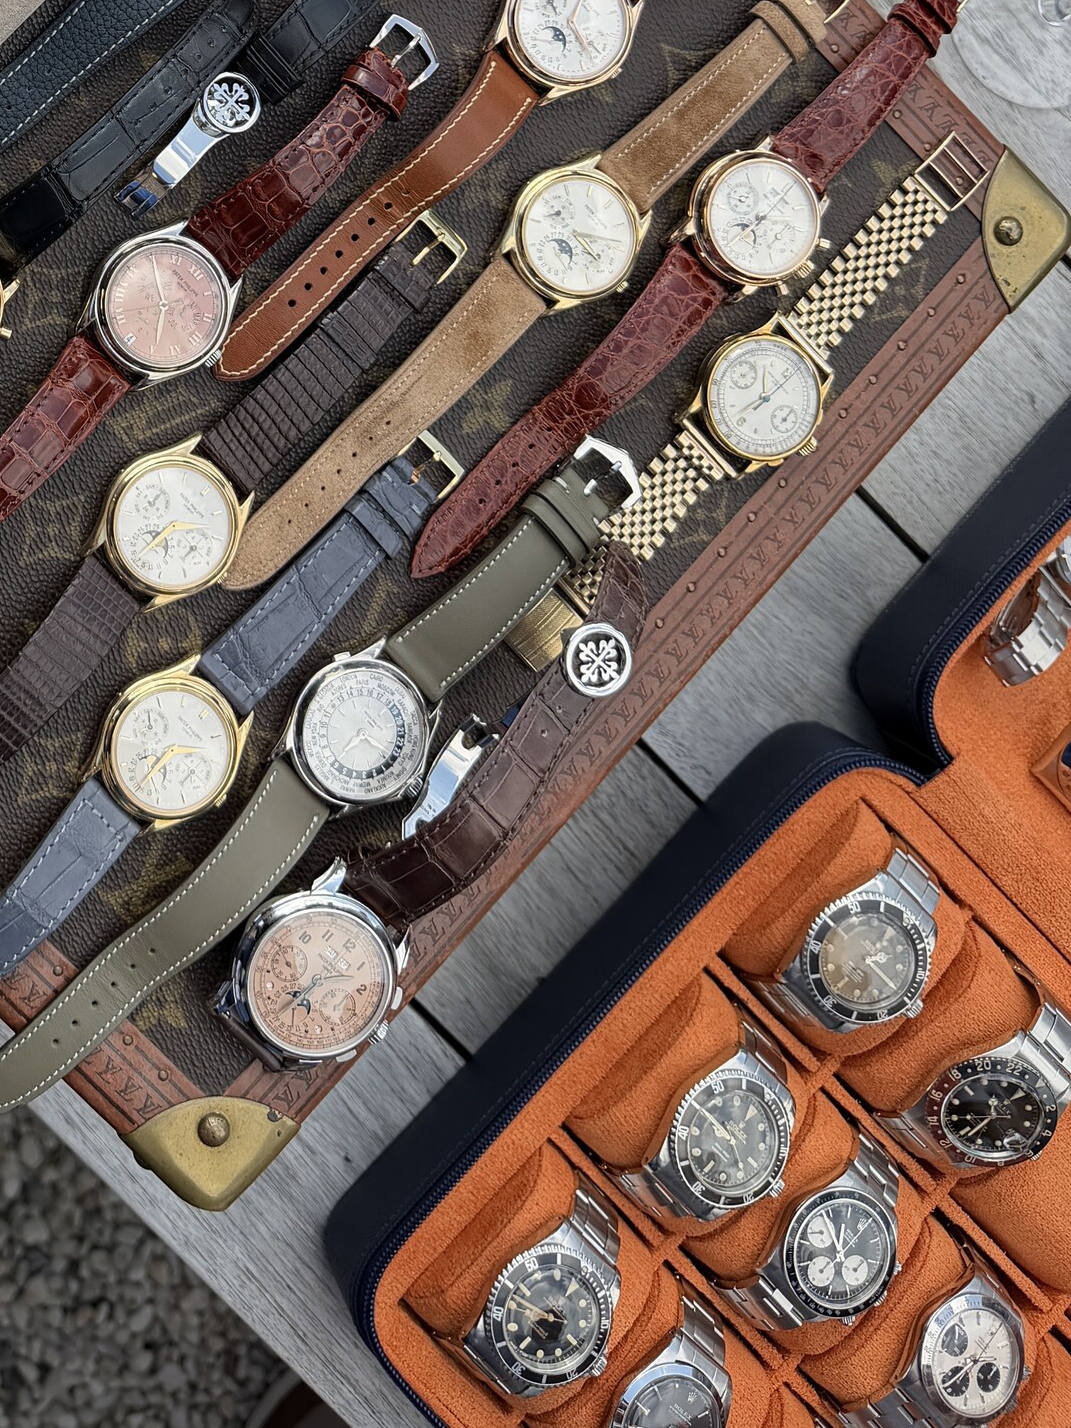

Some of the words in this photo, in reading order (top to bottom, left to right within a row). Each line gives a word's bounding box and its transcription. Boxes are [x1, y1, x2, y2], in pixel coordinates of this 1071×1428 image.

[169, 255, 182, 266] XI
[188, 266, 204, 280] XII
[171, 268, 184, 282] PATEK
[181, 279, 199, 298] PHILIPPE
[203, 313, 212, 323] II
[189, 332, 203, 346] III
[395, 716, 402, 724] 20
[848, 902, 860, 913] 50
[299, 931, 312, 945] 10
[321, 930, 334, 943] 11
[343, 938, 356, 952] 12
[810, 940, 822, 954] 40
[357, 961, 366, 971] 1
[356, 984, 367, 995] 2
[824, 995, 837, 1007] 30
[975, 1061, 991, 1071] 20
[1006, 1063, 1022, 1075] 22
[948, 1069, 962, 1081] 18
[711, 1081, 724, 1093] 50
[930, 1090, 943, 1100] 16
[927, 1116, 939, 1125] 14
[678, 1126, 689, 1140] 40
[729, 1120, 748, 1139] ROLEX
[939, 1139, 953, 1148] 12
[965, 1155, 976, 1163] 10
[692, 1181, 705, 1194] 30
[525, 1258, 539, 1271] 50
[493, 1306, 504, 1321] 40
[512, 1362, 525, 1375] 30
[673, 1403, 692, 1419] ROLEX
